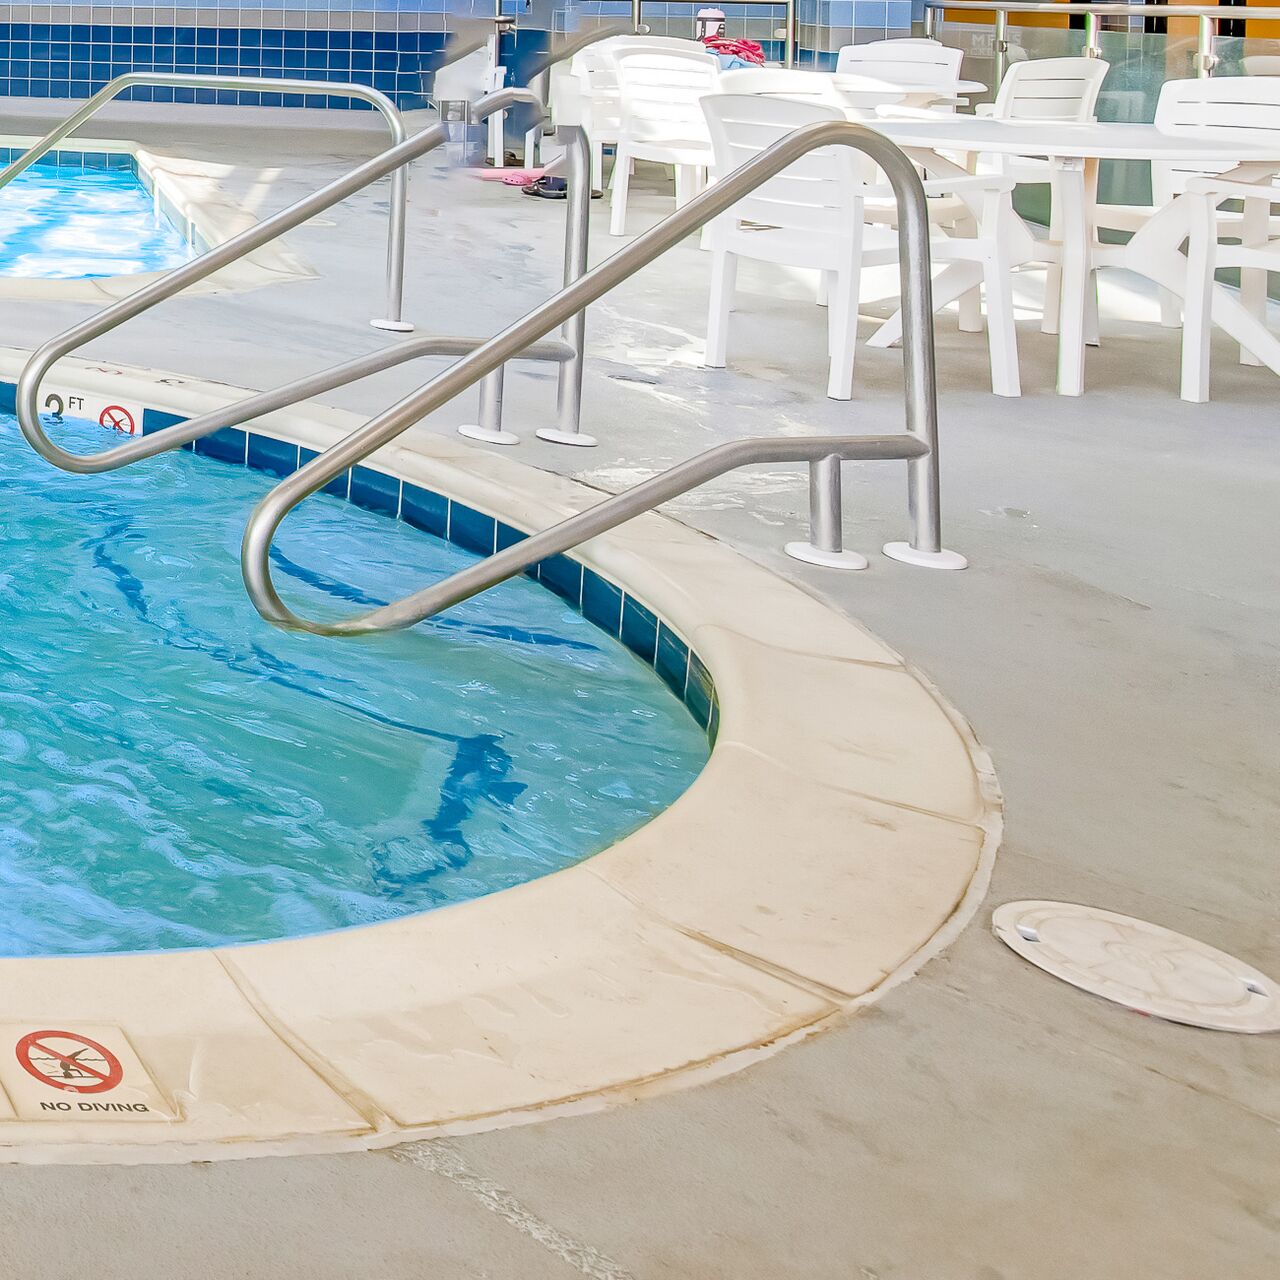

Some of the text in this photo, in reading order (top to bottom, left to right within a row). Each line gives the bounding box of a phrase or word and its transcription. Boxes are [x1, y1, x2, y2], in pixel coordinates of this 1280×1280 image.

[45, 393, 85, 420] 3 FT
[40, 1102, 150, 1113] NO DIVING
